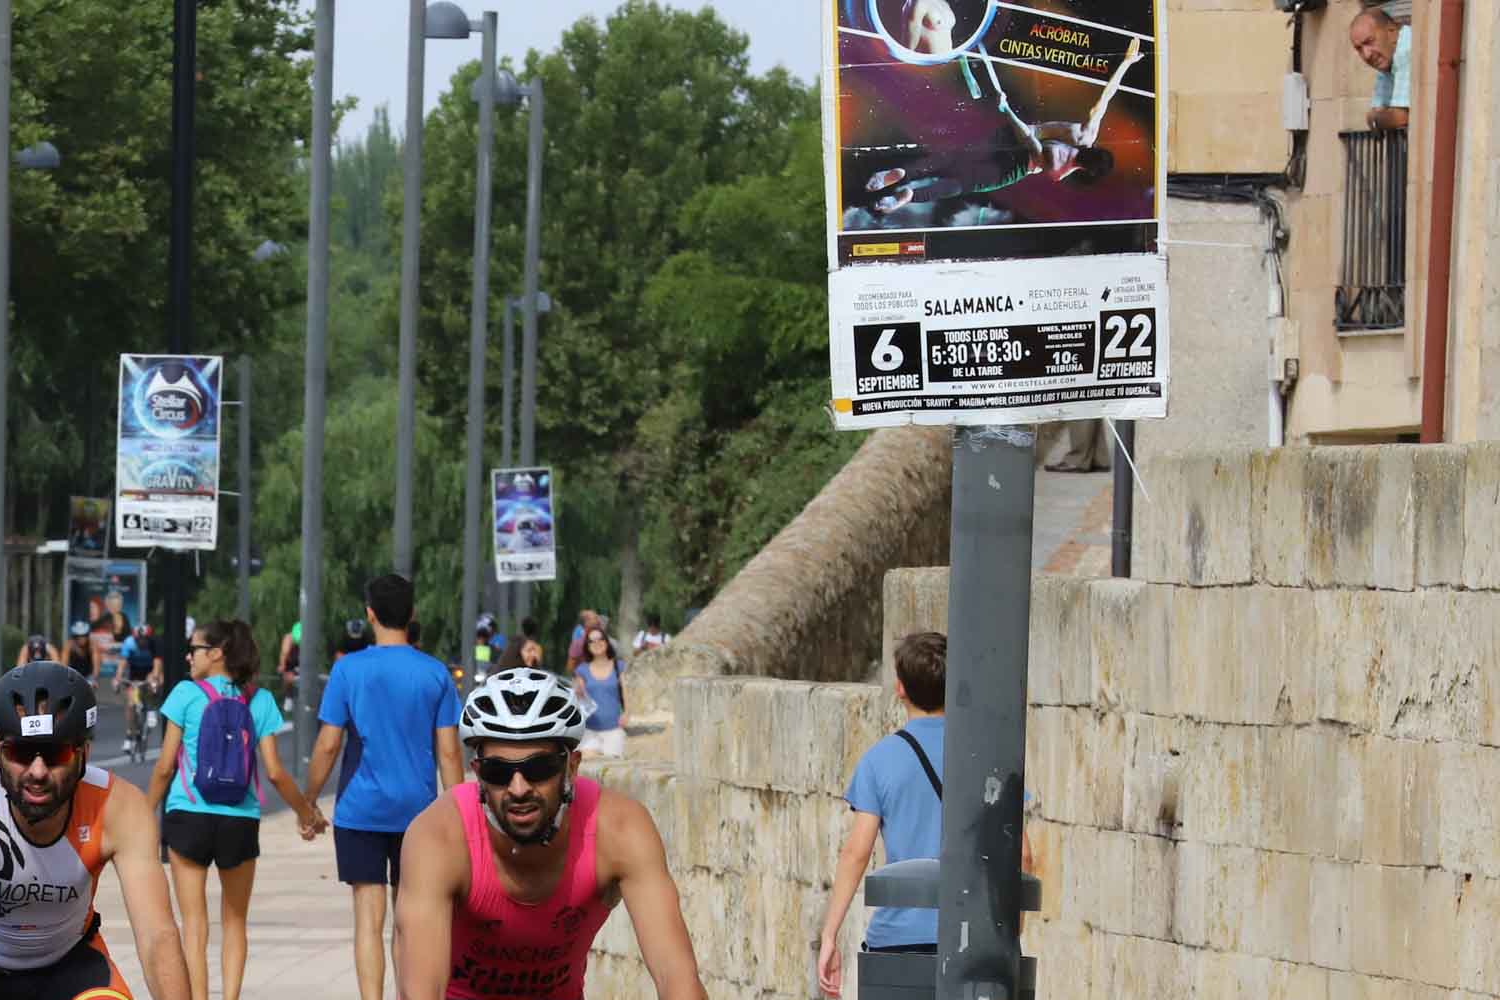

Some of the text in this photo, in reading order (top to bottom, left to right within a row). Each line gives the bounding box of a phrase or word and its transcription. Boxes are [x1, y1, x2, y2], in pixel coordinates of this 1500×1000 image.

[1000, 39, 1042, 59] CINTAS
[1029, 287, 1090, 299] RECINTO FERIAL
[874, 301, 886, 309] LOS
[924, 296, 1014, 316] SALAMANCA
[1032, 301, 1088, 312] LA ALDEHUELA
[944, 330, 970, 343] TODOS
[972, 330, 988, 342] LOS
[1104, 313, 1152, 358] 22
[871, 329, 904, 371] 6
[931, 341, 1022, 365] 5:30 Y 8:30
[1052, 351, 1080, 365] 10€
[953, 365, 1003, 377] DE LA TARDE
[1045, 363, 1083, 374] TRIBUNA
[1100, 361, 1153, 378] SEPTIEMBRE
[858, 374, 919, 392] SEPTIEMBRE
[862, 402, 882, 412] NUEVA
[1031, 395, 1043, 403] LOS
[1078, 391, 1086, 399] AL
[1105, 388, 1116, 397] QUE
[152, 408, 186, 421] Circus
[125, 514, 137, 528] 6
[29, 720, 41, 728] 20
[468, 937, 575, 963] SANCHE
